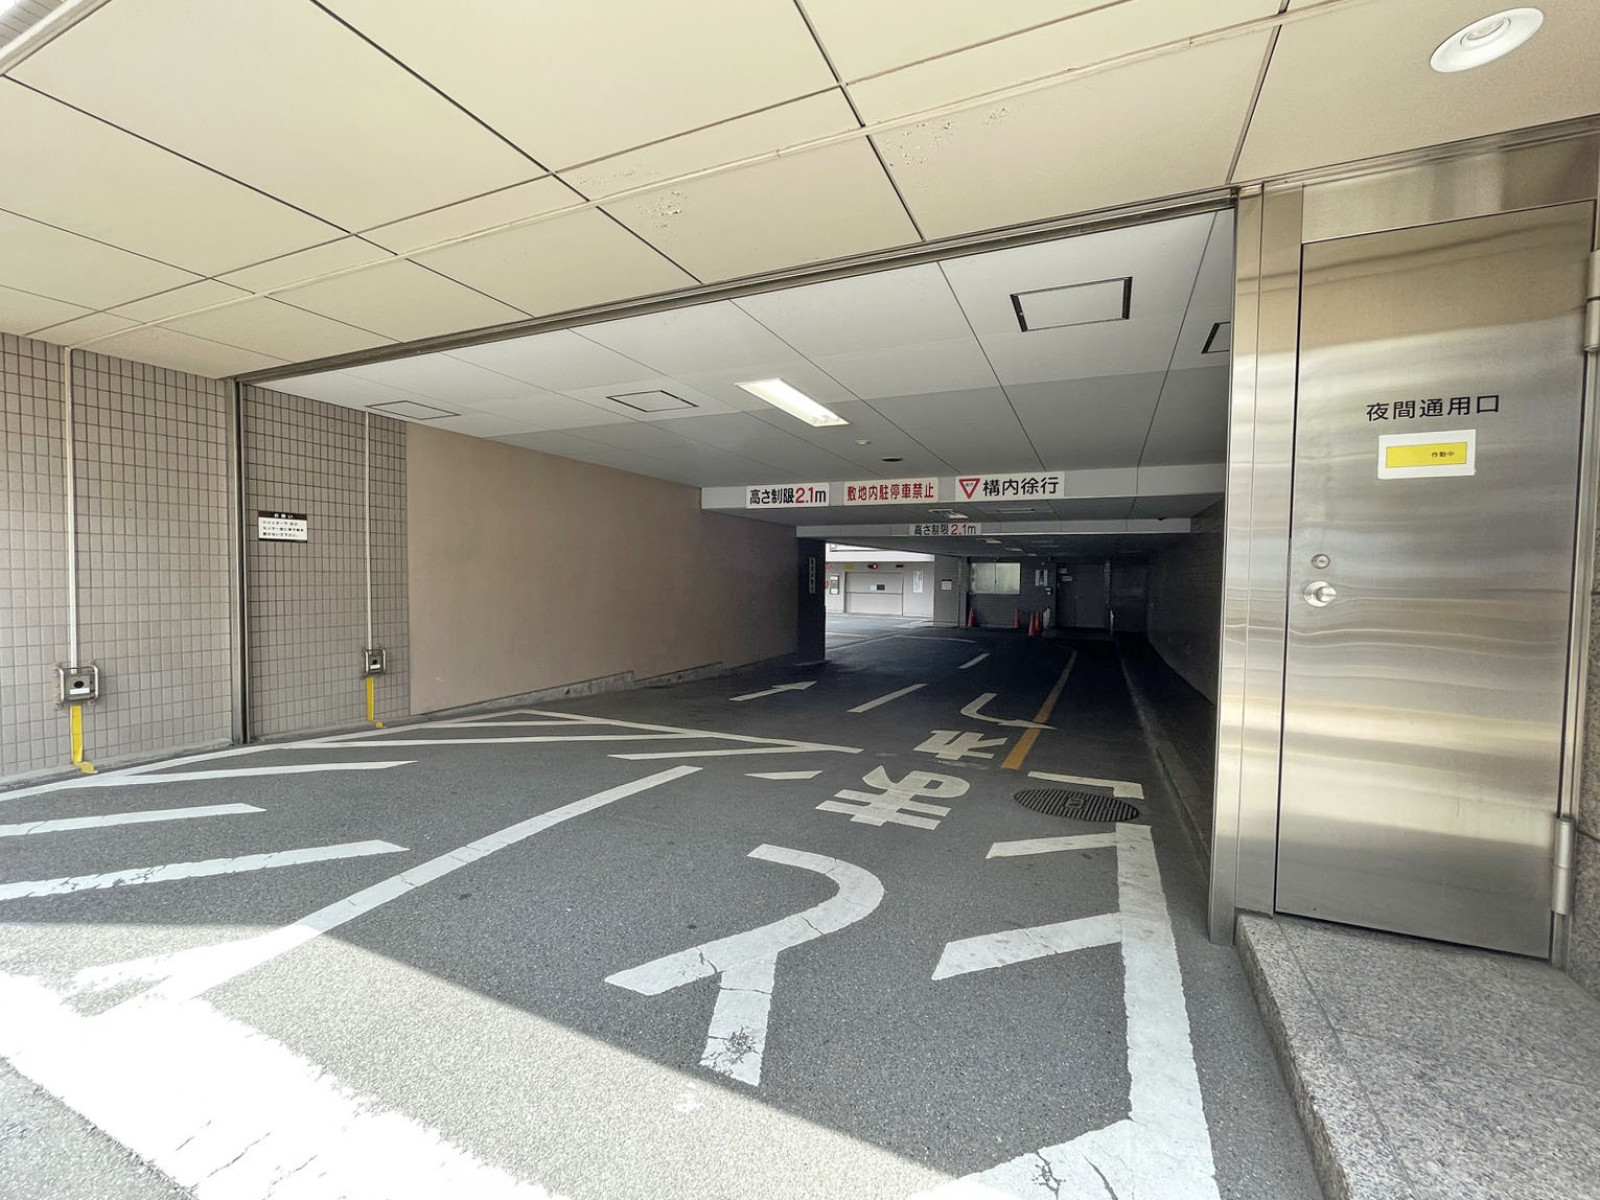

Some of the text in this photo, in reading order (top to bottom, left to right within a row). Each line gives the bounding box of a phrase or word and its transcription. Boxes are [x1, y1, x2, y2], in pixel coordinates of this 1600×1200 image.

[1366, 395, 1499, 421] 夜間通用口
[750, 486, 826, 504] 高さ制限2.1m
[847, 482, 934, 501] 敷地内駐停車禁止
[983, 476, 1059, 497] 構内徐行
